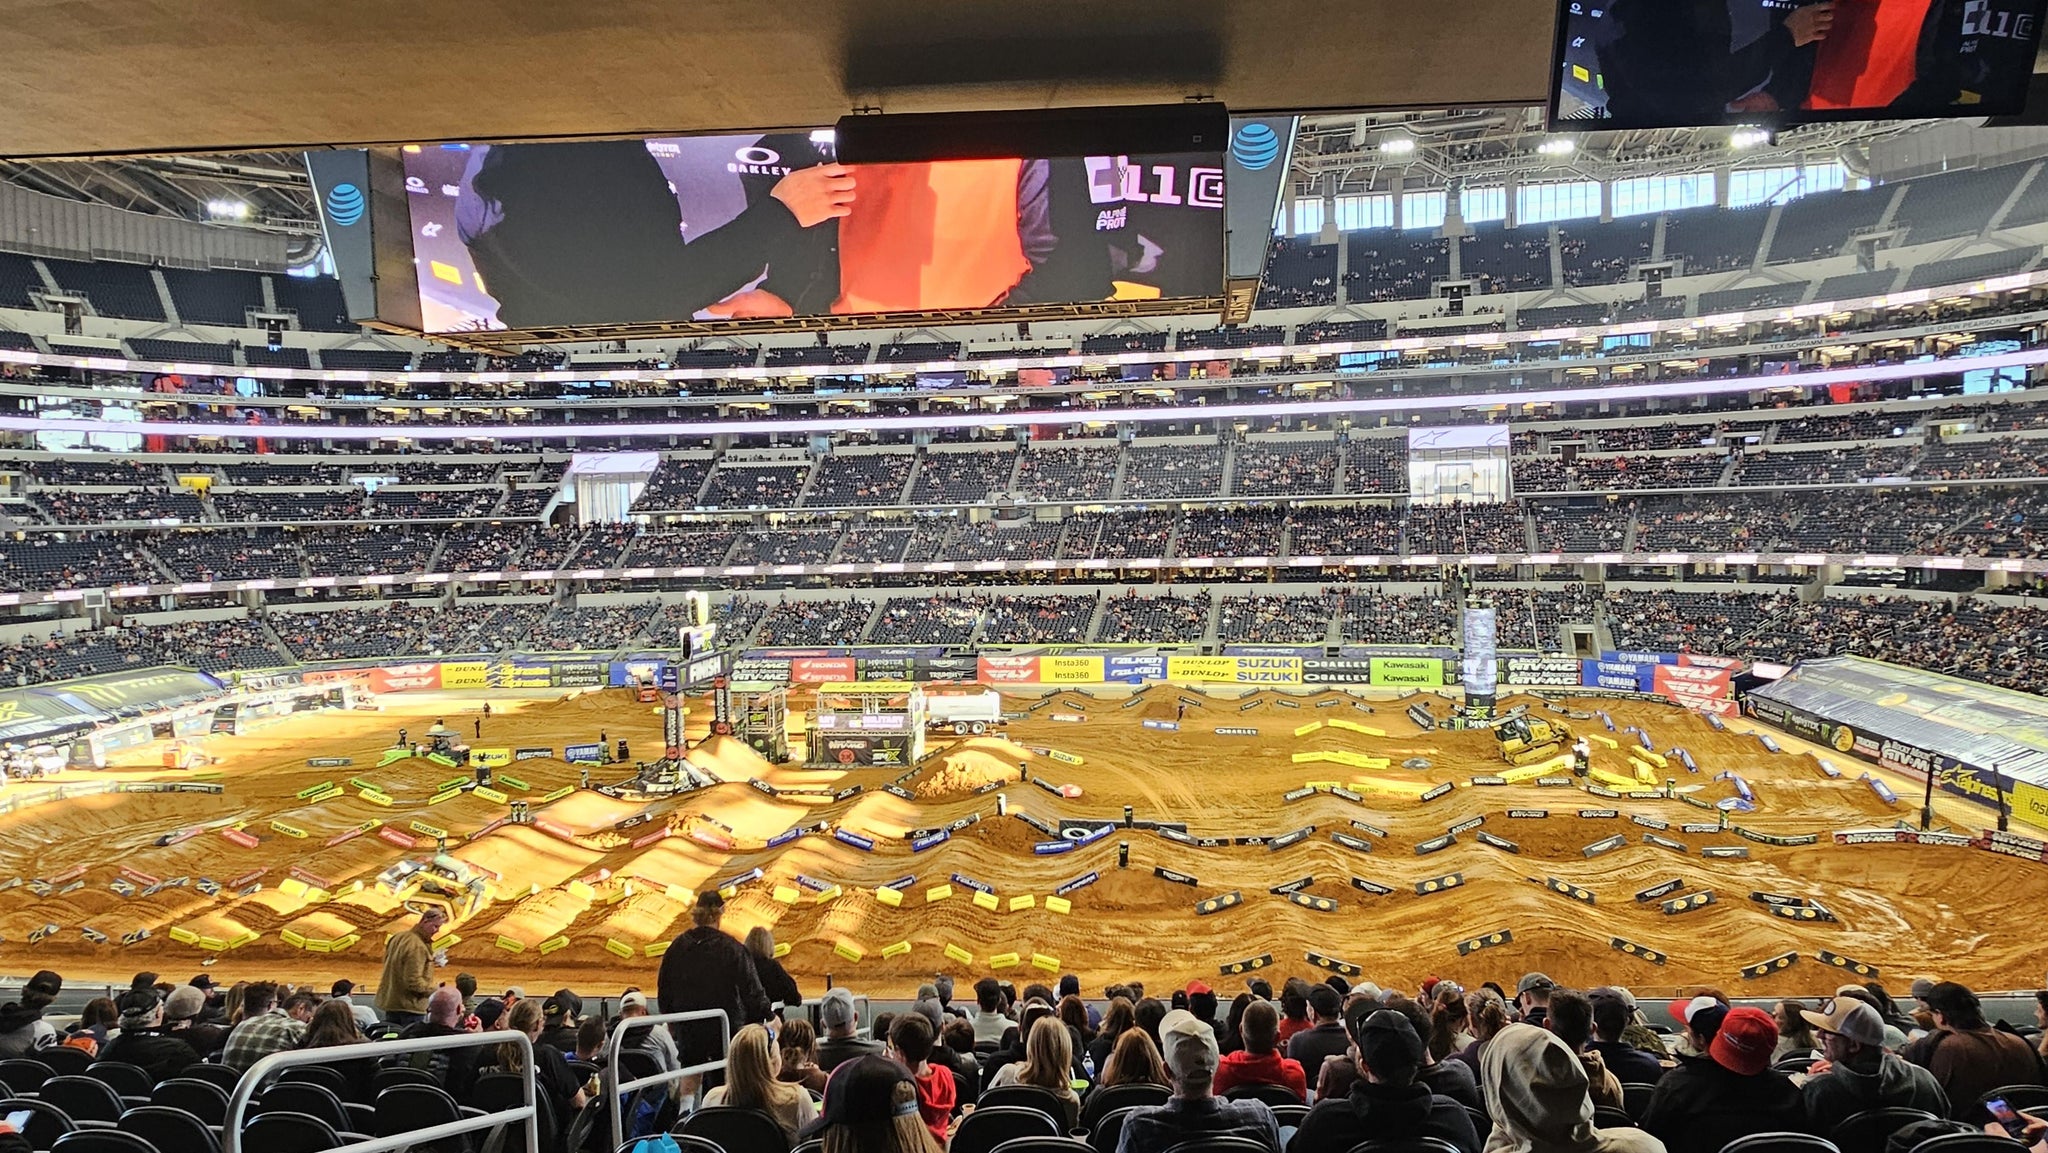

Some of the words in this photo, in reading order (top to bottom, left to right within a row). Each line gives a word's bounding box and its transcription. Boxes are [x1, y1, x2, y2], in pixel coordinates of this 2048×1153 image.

[727, 163, 791, 176] OAKLEY
[1963, 319, 2002, 329] PEARSON
[1787, 339, 1823, 348] SCHRAMM
[929, 659, 958, 667] TRIUMPH
[1055, 659, 1089, 667] Insta360
[1111, 657, 1163, 665] FALKEN
[1237, 658, 1298, 668] SUZUKI
[1320, 660, 1368, 668] OAKLEY
[1628, 655, 1660, 663] YAMAHA
[1383, 661, 1429, 669] Kawasaki
[1605, 664, 1637, 673] YAMAHA
[929, 671, 957, 679] TRIUMPH
[1110, 666, 1162, 676] FALKEN
[1237, 671, 1298, 681] SUZUKI
[1662, 665, 1726, 680] FLY
[1320, 673, 1368, 681] OAKLEY
[1383, 674, 1429, 683] Kawasaki
[1605, 676, 1636, 685] YAMAHA
[1661, 680, 1722, 695] FLY
[1791, 714, 1820, 732] MONSTER
[1053, 751, 1076, 763] SUZUKI
[364, 789, 389, 803] SUZUKI
[476, 788, 504, 800] SUZUKI
[273, 822, 302, 837] SUZUKI
[412, 822, 443, 836] SUZUKI
[956, 875, 988, 891] FALKEN
